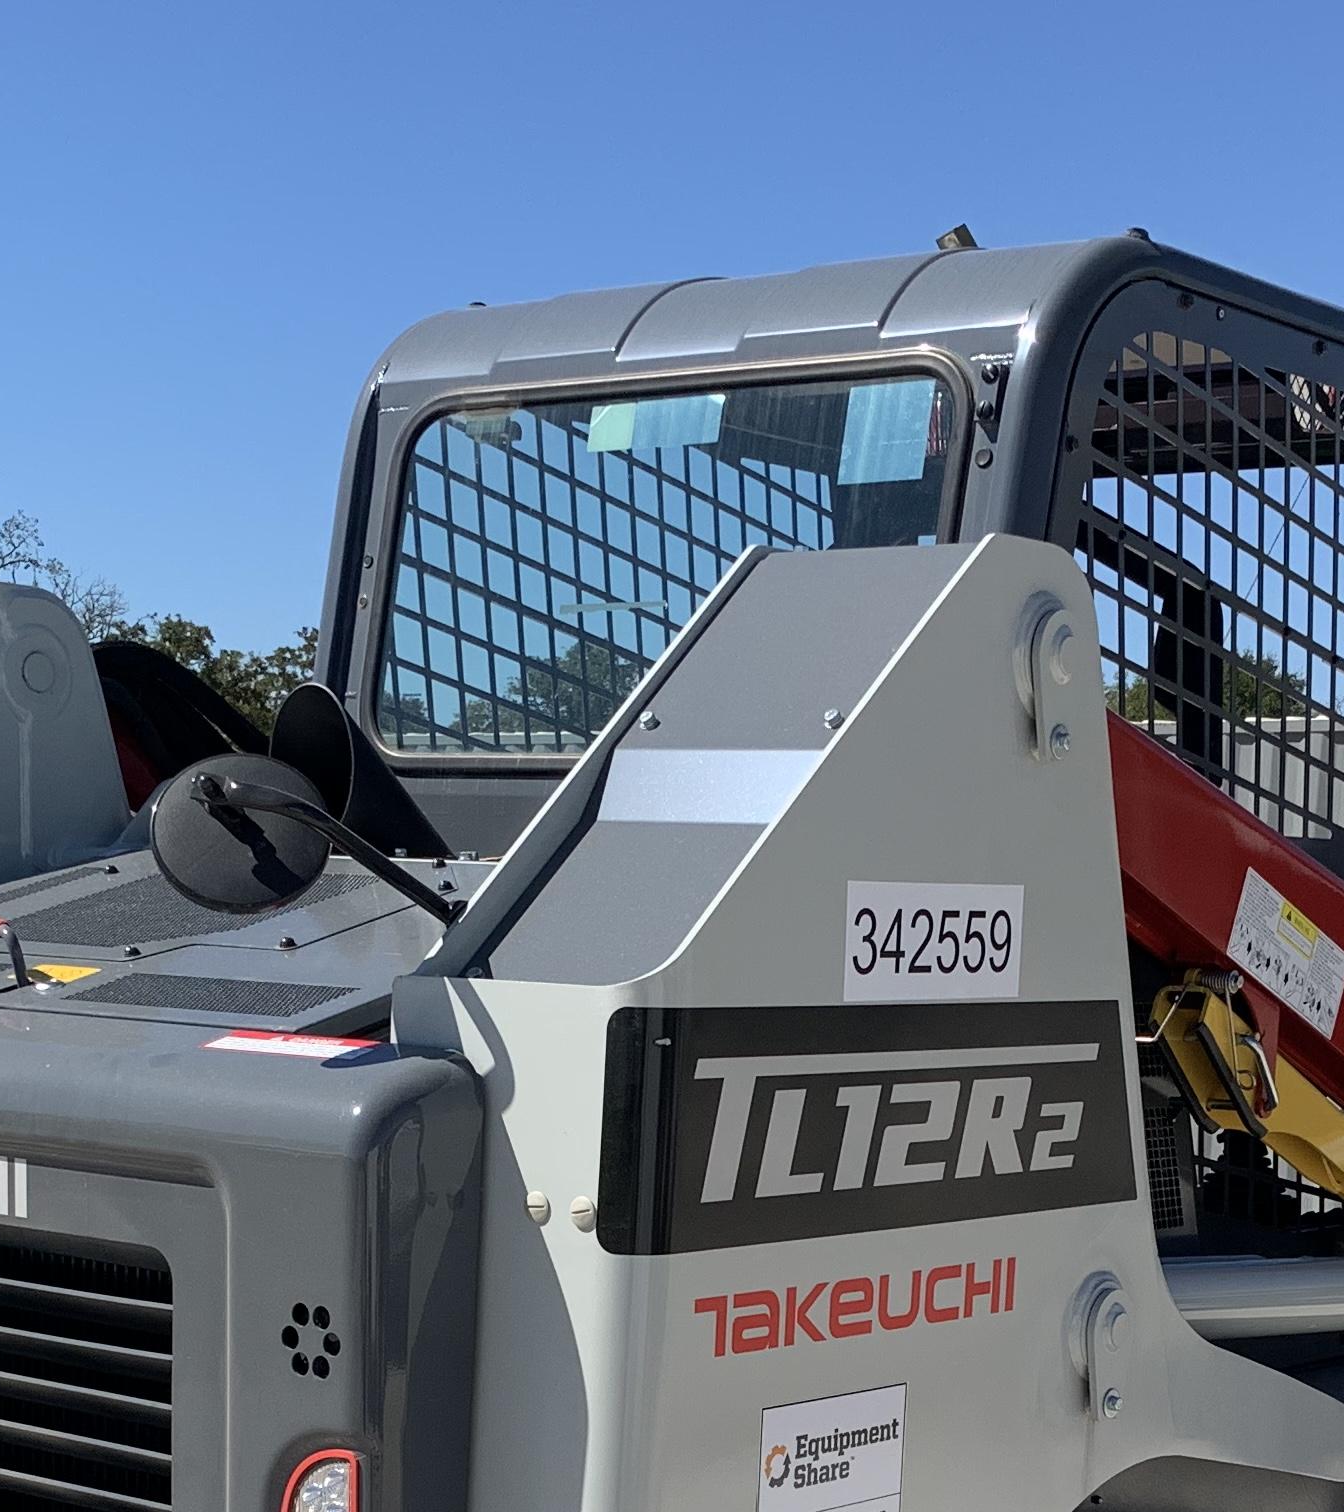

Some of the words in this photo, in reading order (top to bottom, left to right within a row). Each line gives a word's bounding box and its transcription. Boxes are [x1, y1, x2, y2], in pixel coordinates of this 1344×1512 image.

[852, 907, 1013, 975] 342559
[694, 1043, 1100, 1203] TL12R2
[794, 1418, 899, 1461] Equipment
[793, 1460, 850, 1489] Share
